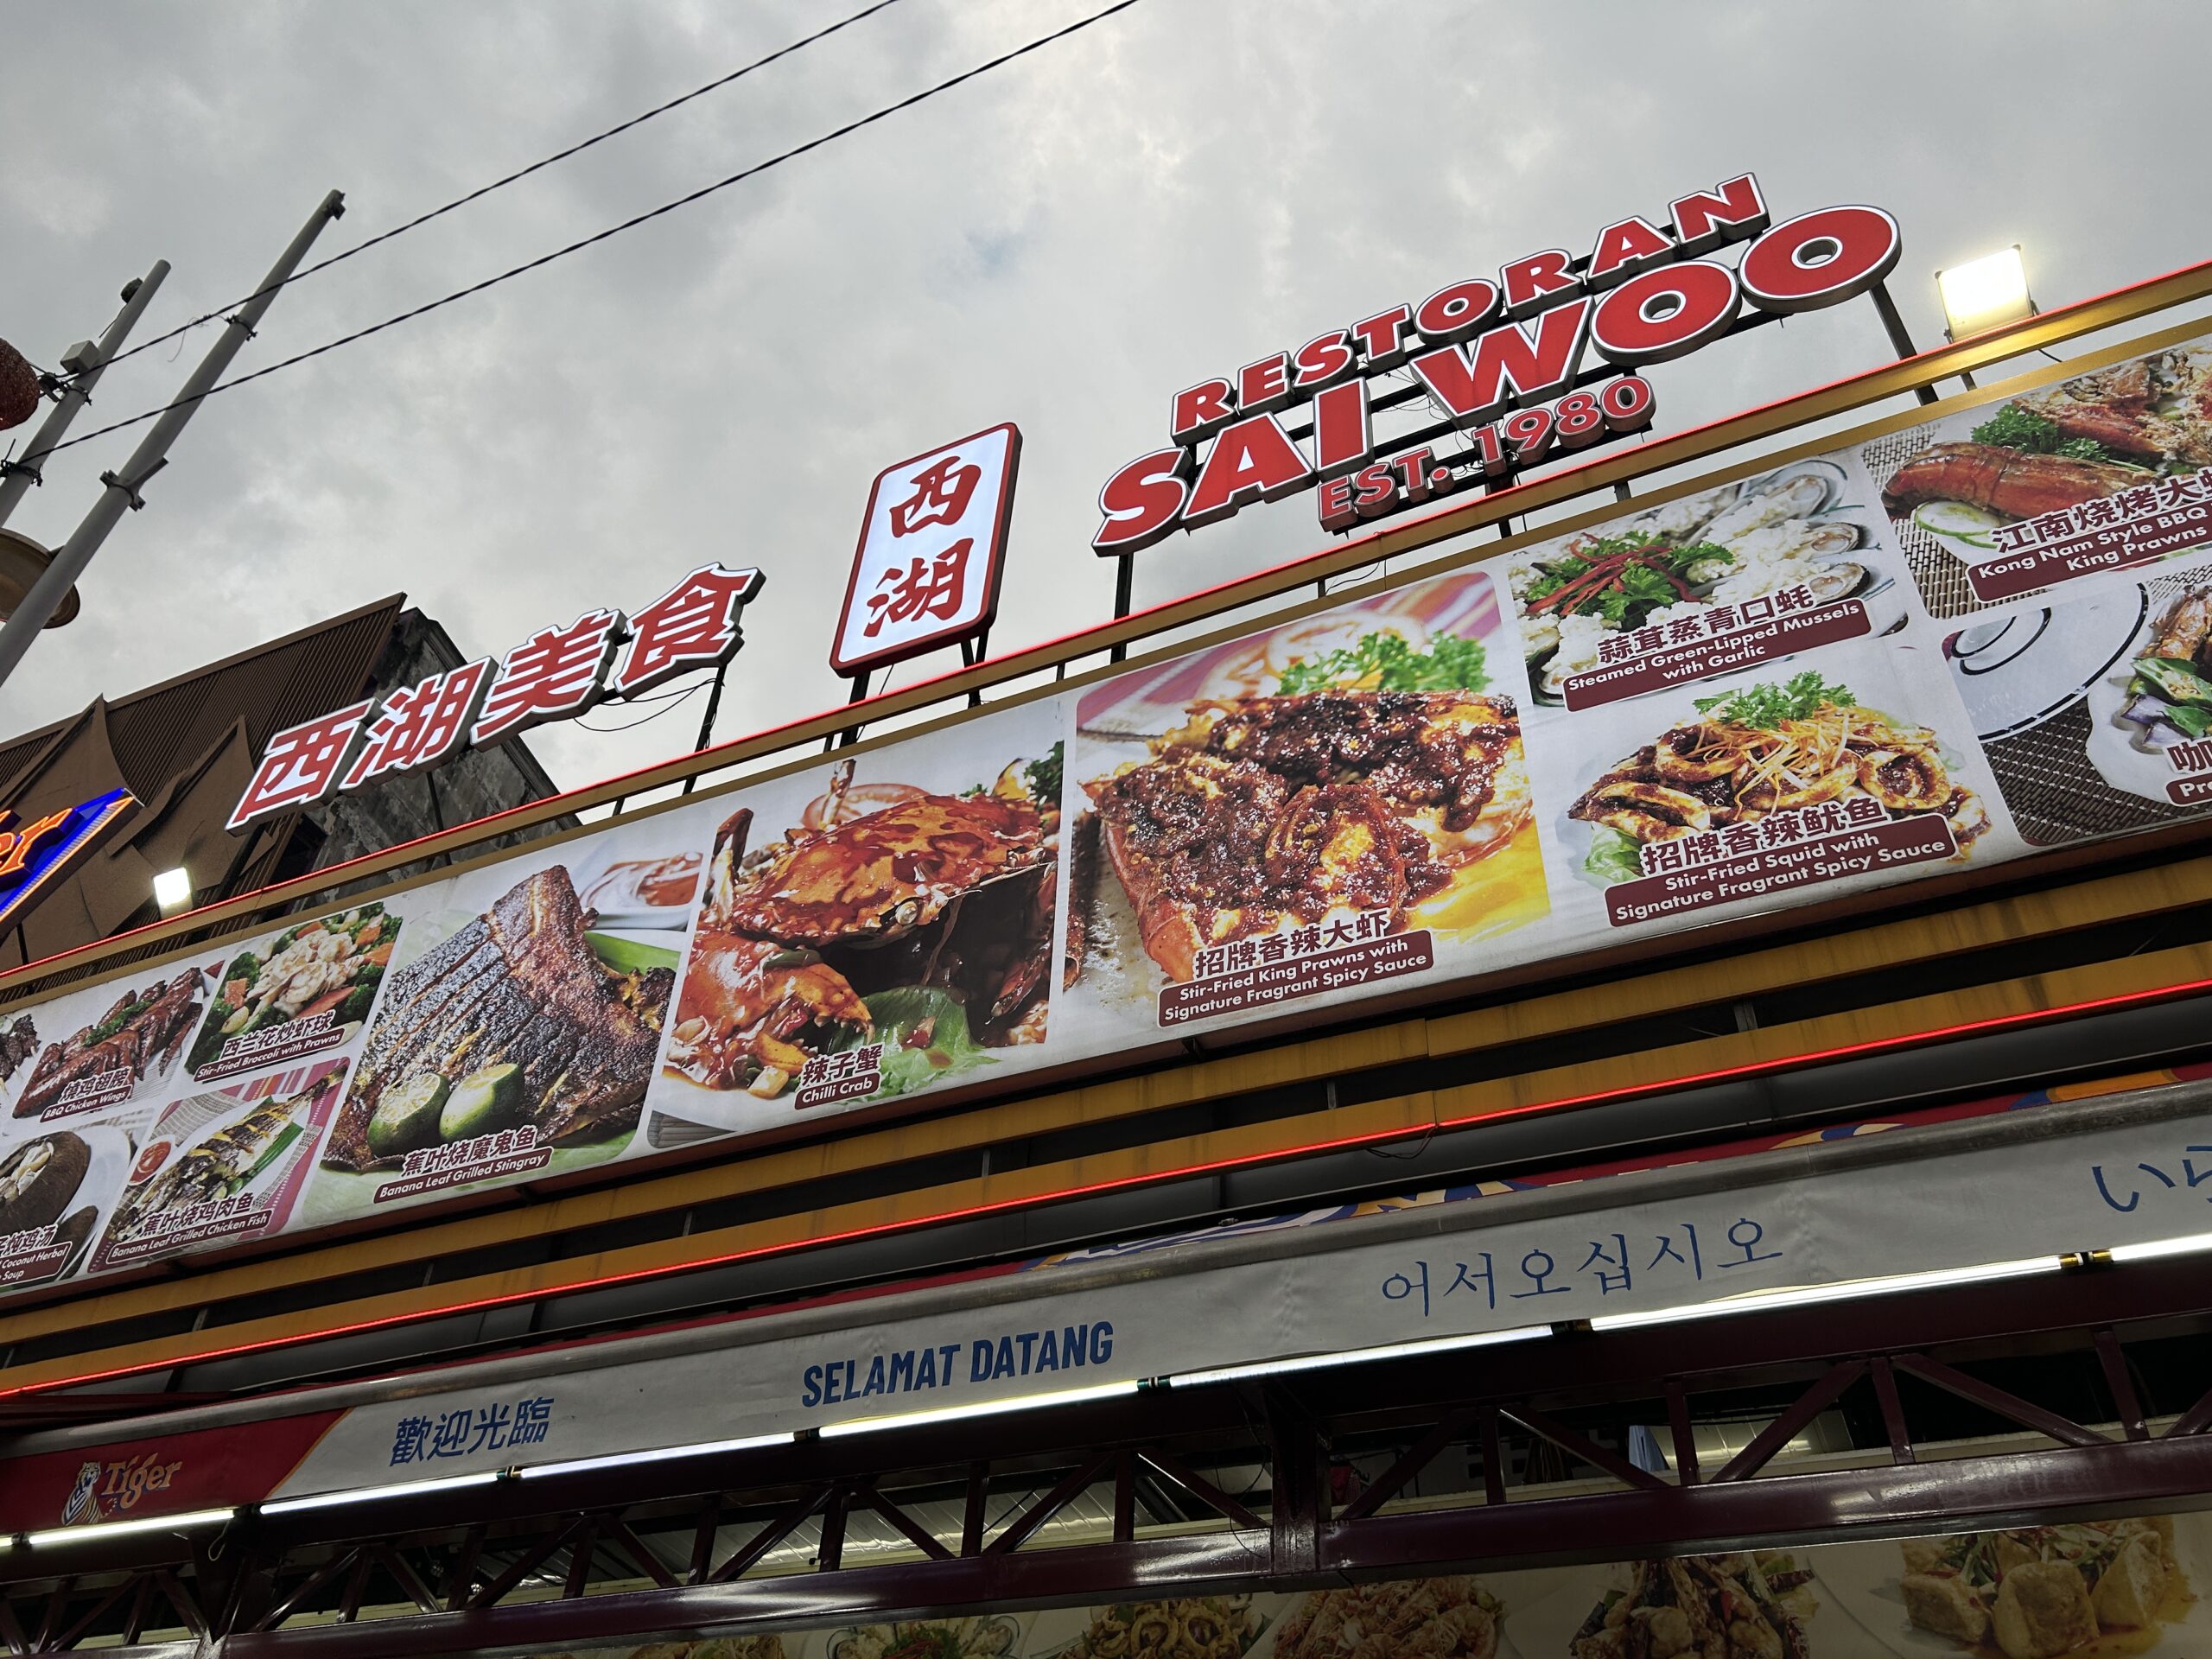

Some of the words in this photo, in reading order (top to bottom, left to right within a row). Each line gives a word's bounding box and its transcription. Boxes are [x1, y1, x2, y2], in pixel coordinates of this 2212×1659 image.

[1173, 172, 1766, 439] RESTORAN
[1092, 378, 1369, 551] SAI
[1408, 205, 1900, 420] WOO
[1317, 446, 1454, 522] EST.
[1473, 376, 1654, 463] 1980
[864, 454, 982, 638] 西湖
[1978, 554, 2036, 579] Kong
[2038, 539, 2093, 562] Nam
[2097, 523, 2153, 546] Style
[2157, 507, 2209, 528] BBQ
[2066, 551, 2120, 572] King
[2122, 525, 2207, 556] Prawns
[1568, 659, 1647, 690] Steamed
[1650, 624, 1778, 668] Green-Lipped
[1783, 604, 1859, 631] Mussels
[1598, 588, 1814, 664] 蒜茸蒸青口蚝
[1662, 662, 1704, 681] with
[1707, 645, 1766, 666] Garlic
[226, 563, 759, 828] 西湖美食
[1643, 798, 1889, 875] 招牌香辣鱿鱼
[1665, 862, 1758, 891] Stir-Fried
[1764, 844, 1826, 868] Squid
[1830, 833, 1880, 854] with
[1616, 888, 1713, 920] Signature
[1719, 868, 1808, 900] Fragrant
[1815, 854, 1873, 878] Spicy
[1878, 840, 1946, 861] Sauce
[1179, 976, 1254, 1001] Stir-Fried
[1258, 965, 1297, 982] King
[1301, 952, 1365, 974] Prawns
[1370, 940, 1408, 957] with
[1195, 910, 1390, 978] 招牌香辣大虾
[1165, 995, 1243, 1020] Signature
[1247, 977, 1319, 1002] Fragrant
[1322, 967, 1369, 988] Spicy
[1374, 955, 1427, 975] Sauce
[197, 1059, 239, 1078] Stir-Fried
[242, 1049, 279, 1065] Broccoli
[281, 1044, 302, 1055] with
[303, 1033, 340, 1049] Prawns
[222, 1013, 334, 1057] 西兰花炒虾球
[802, 1045, 883, 1085] 辣子蟹
[43, 1106, 64, 1119] BBQ
[65, 1098, 98, 1112] Chicken
[99, 1091, 127, 1104] Wings
[802, 1084, 836, 1103] Chilli
[839, 1077, 873, 1094] Crab
[379, 1181, 423, 1198] Banana
[426, 1174, 450, 1188] Leaf
[453, 1165, 492, 1182] Grilled
[494, 1154, 545, 1173] Stingray
[402, 1127, 536, 1177] 蕉叶烧魔鬼鱼
[111, 1244, 146, 1259] Banana
[149, 1236, 170, 1250] Leaf
[171, 1228, 204, 1243] Grilled
[207, 1220, 245, 1236] Chicken
[247, 1214, 267, 1226] Fish
[142, 1192, 254, 1236] 蕉叶烧鸡肉鱼
[2, 1254, 35, 1268] Coconut
[35, 1245, 68, 1262] Herbal
[3, 1270, 24, 1280] Soup
[1382, 1217, 1784, 1319] 어서오십시오
[801, 1343, 962, 1408] SELAMAT
[971, 1320, 1115, 1382] DATANG
[389, 1396, 555, 1467] 歡迎光臨
[101, 1452, 183, 1509] Tiger
